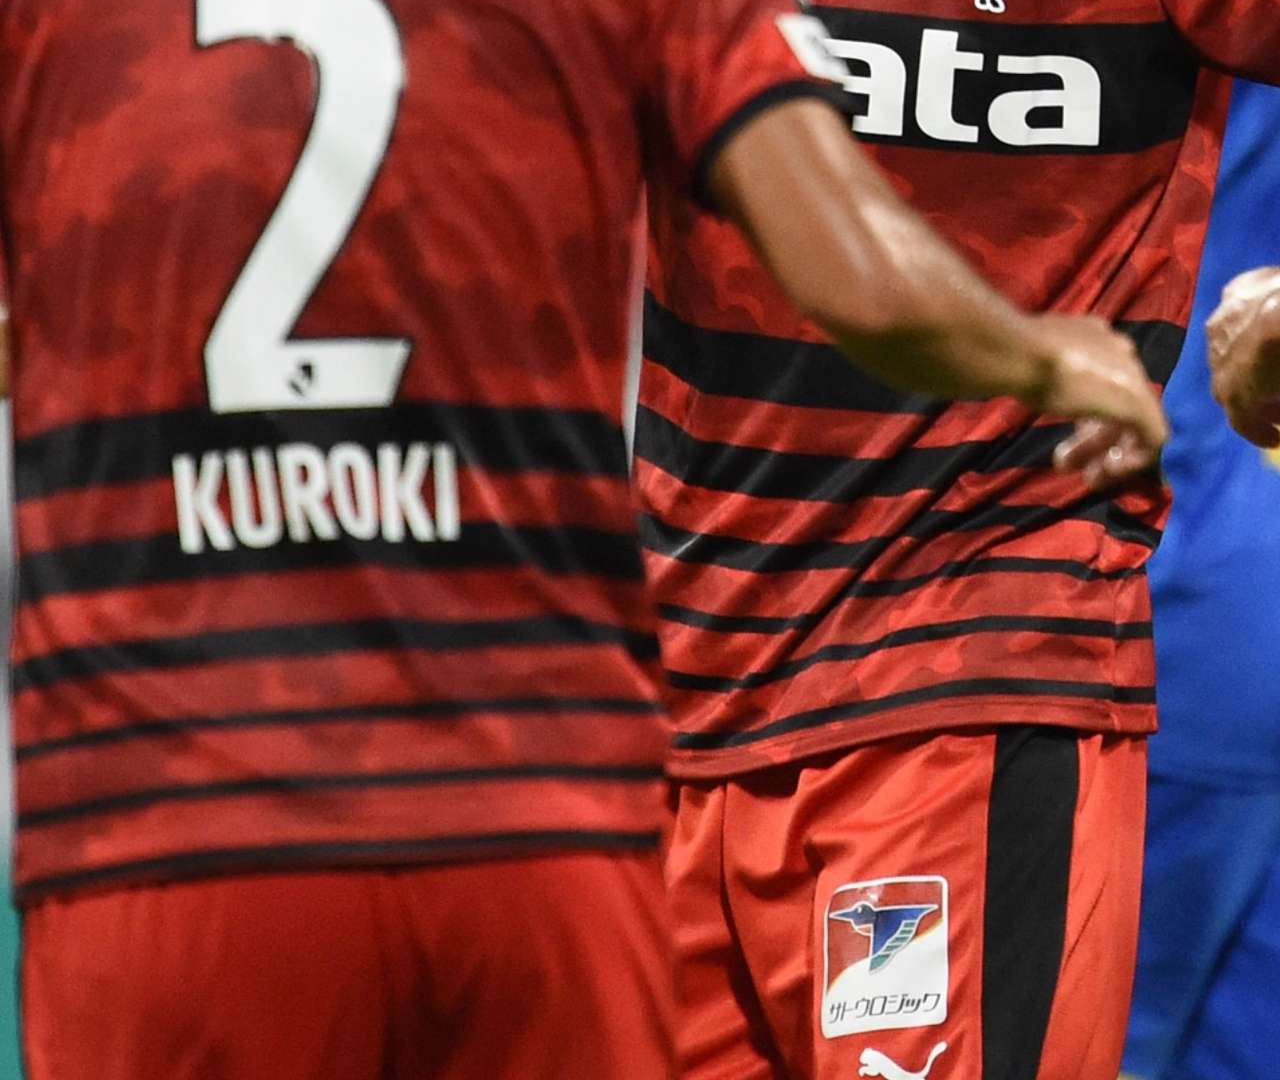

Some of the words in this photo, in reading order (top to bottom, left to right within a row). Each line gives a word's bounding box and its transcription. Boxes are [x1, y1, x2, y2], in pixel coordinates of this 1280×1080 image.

[173, 444, 458, 553] KUROKI
[828, 992, 941, 1024] サトウロジック
